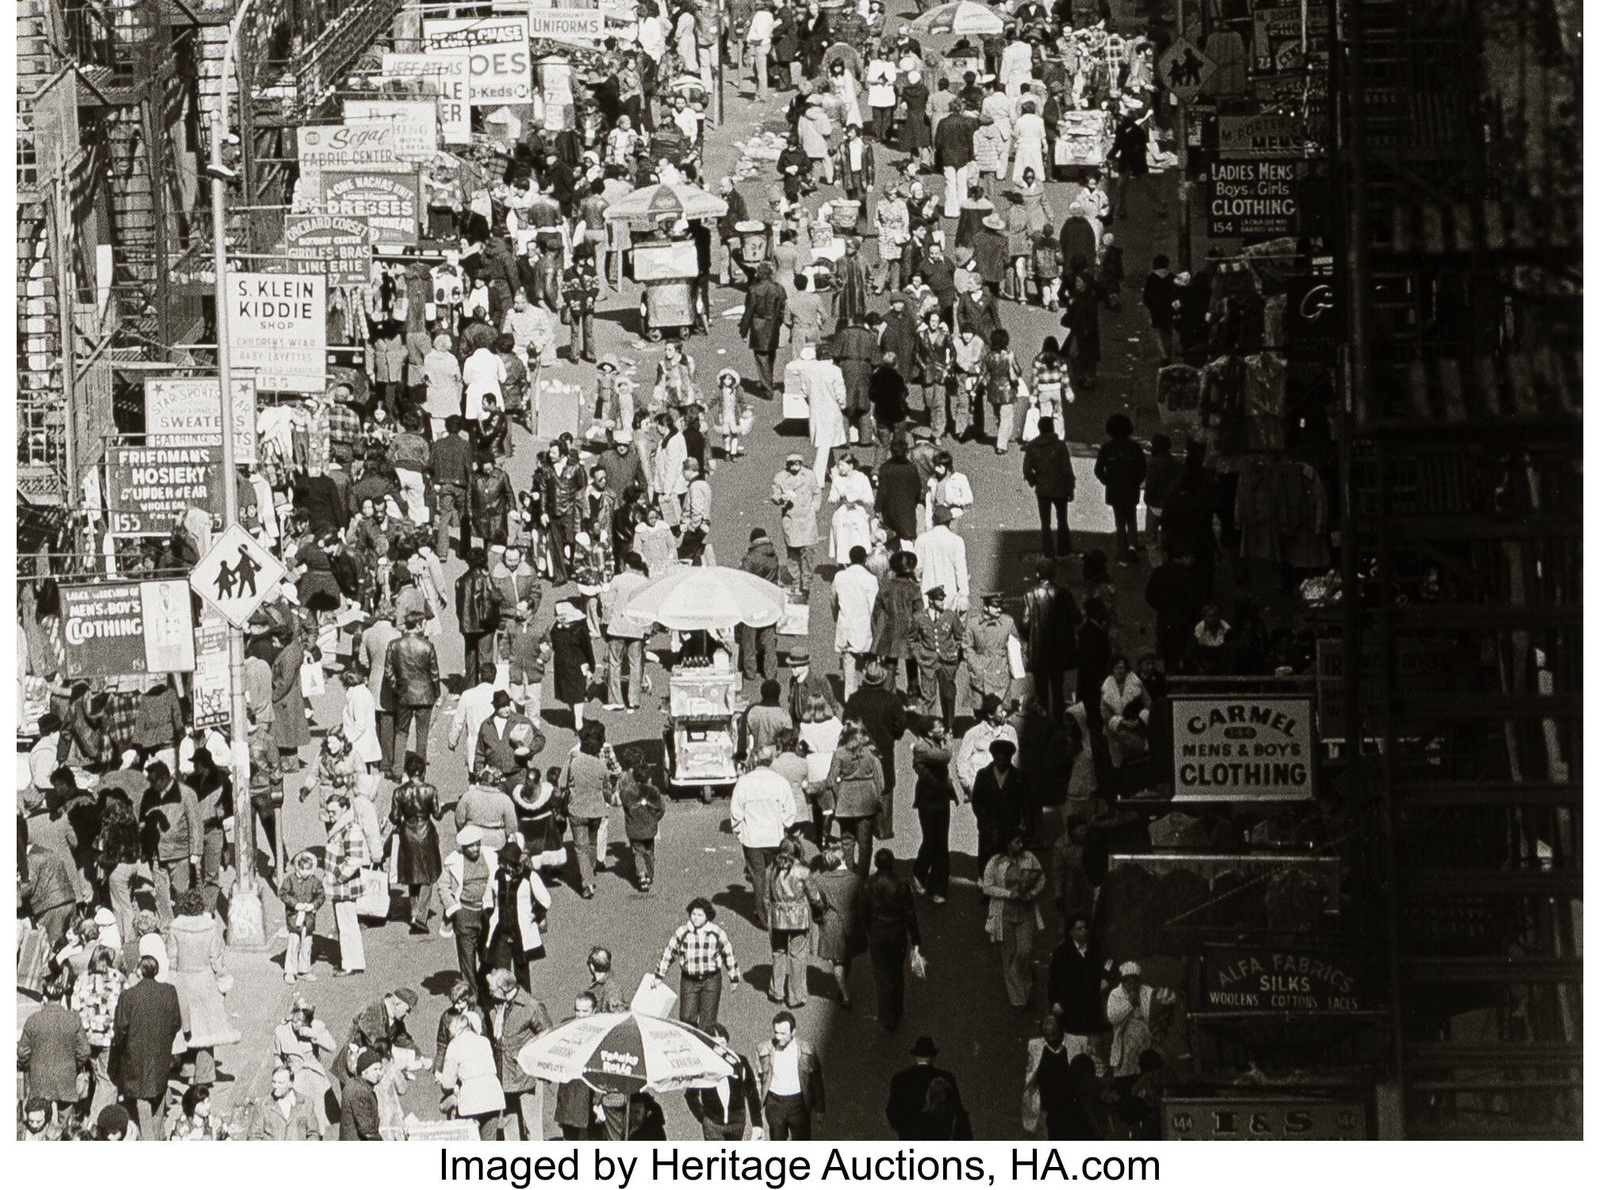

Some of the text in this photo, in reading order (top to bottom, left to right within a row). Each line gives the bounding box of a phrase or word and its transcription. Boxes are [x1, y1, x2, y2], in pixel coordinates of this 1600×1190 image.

[533, 18, 600, 34] UNIFORMS
[469, 53, 527, 76] OES
[328, 128, 390, 150] Segal
[303, 149, 393, 167] FABRIC CENTER
[1211, 162, 1293, 180] LADIES MENS
[1216, 181, 1290, 197] Boys Girls
[326, 200, 414, 217] DRESSES
[1211, 198, 1296, 216] CLOTHING
[286, 216, 332, 242] ORCHARD
[332, 217, 368, 238] CORSET
[1213, 221, 1233, 233] 154
[297, 260, 364, 274] LINGERIE
[238, 280, 313, 298] S. KLEIN
[239, 301, 312, 319] KIDDIE
[260, 321, 294, 330] SHOP
[132, 466, 206, 485] HOSIERY
[65, 617, 143, 646] CLOTHING
[1187, 705, 1296, 738] CARMEL
[1182, 743, 1231, 757] MENS
[1238, 743, 1249, 757] &
[1180, 762, 1307, 786] CLOTHING
[1219, 953, 1355, 993] ALFA FABRICS
[1259, 974, 1311, 992] SILKS
[1209, 990, 1358, 1010] WOOLENS COTTONS LACES
[1212, 1111, 1237, 1135] I
[1249, 1113, 1272, 1134] &
[1283, 1111, 1314, 1134] S
